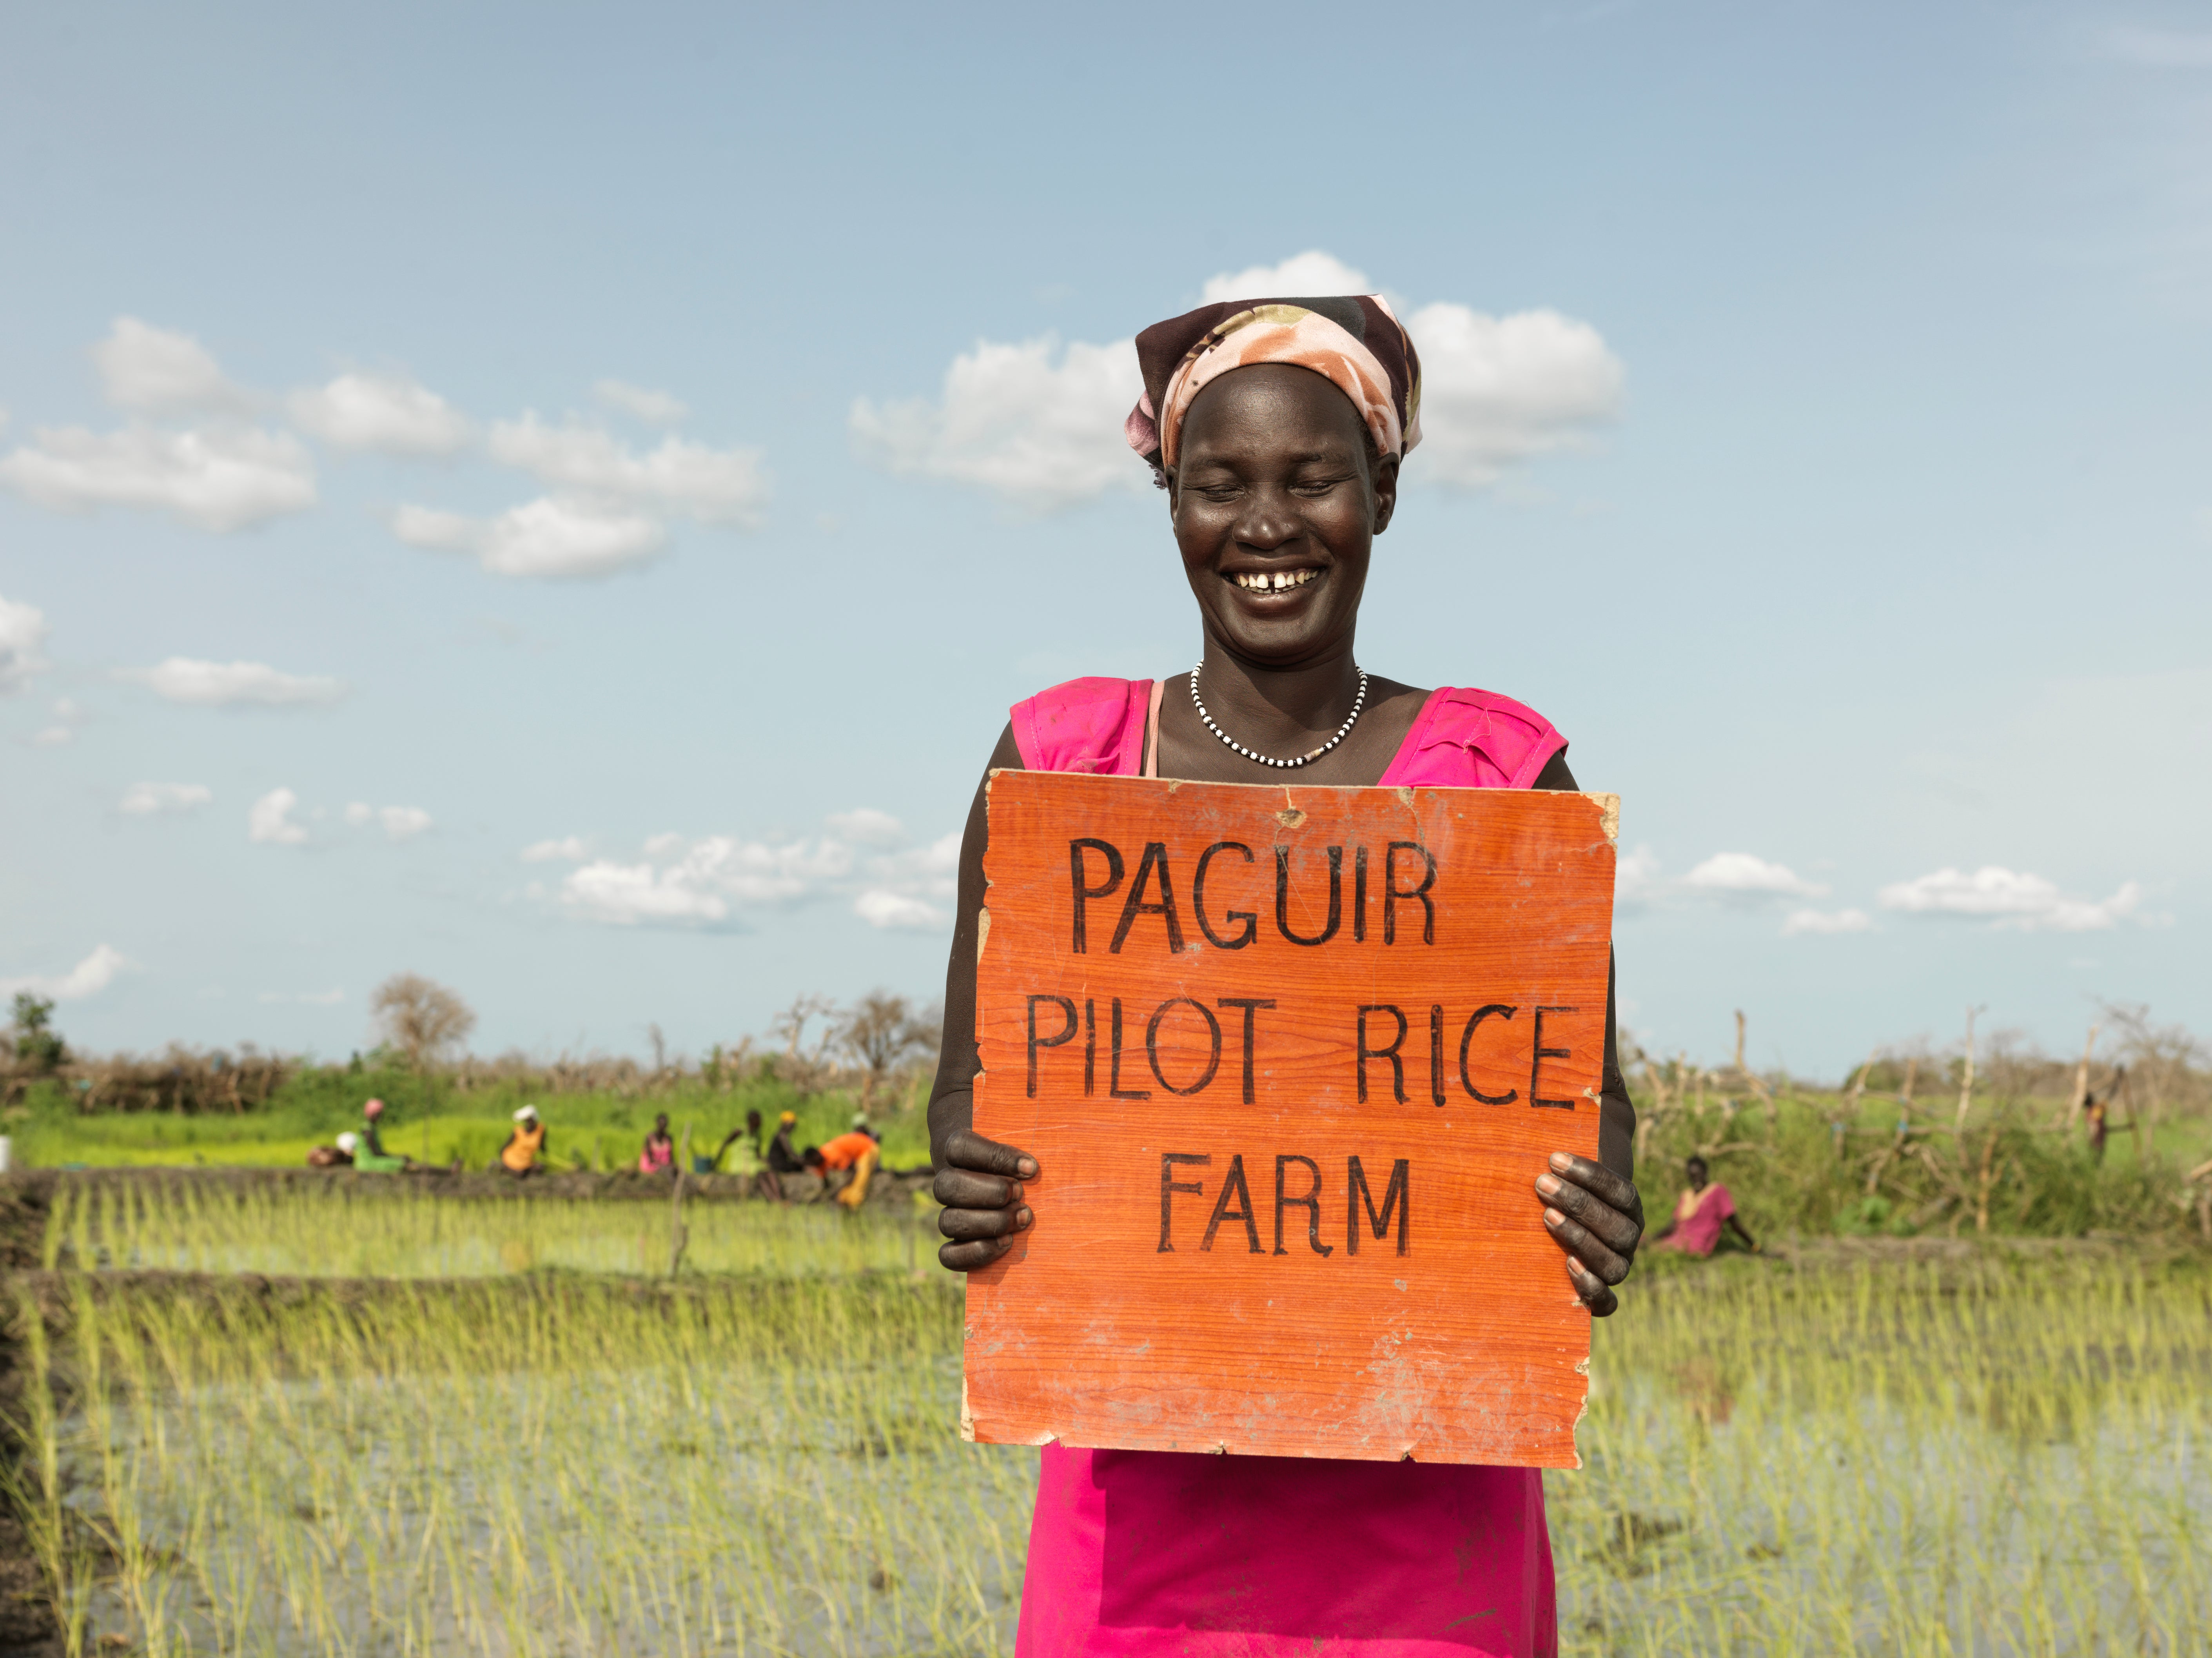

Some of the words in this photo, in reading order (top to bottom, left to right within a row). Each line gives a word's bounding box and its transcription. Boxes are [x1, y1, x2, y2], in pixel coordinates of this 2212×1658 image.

[1069, 838, 1437, 954] PAGUIR
[1026, 995, 1277, 1105] PILOT
[1356, 1004, 1580, 1109] RICE
[1157, 1153, 1411, 1258] FARM
